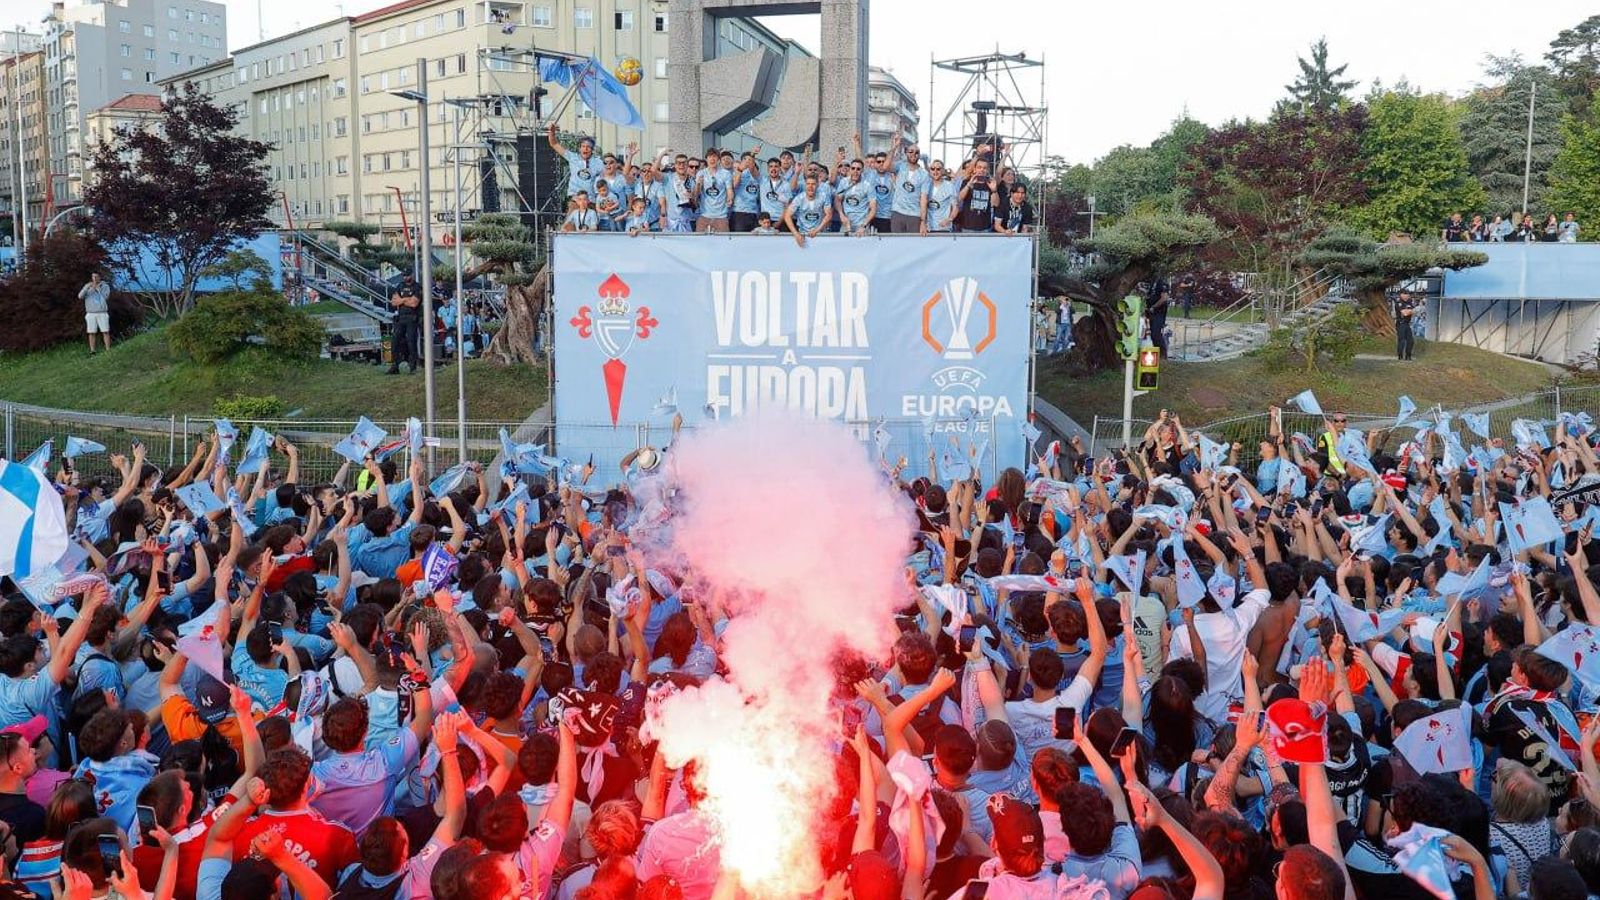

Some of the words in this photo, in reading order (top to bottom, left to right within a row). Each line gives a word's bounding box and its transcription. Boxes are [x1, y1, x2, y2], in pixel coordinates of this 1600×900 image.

[711, 270, 869, 348] VOLTAR
[782, 349, 798, 365] A
[934, 370, 981, 388] UEFA
[902, 395, 1013, 417] EUROPA
[930, 421, 990, 433] EAGE
